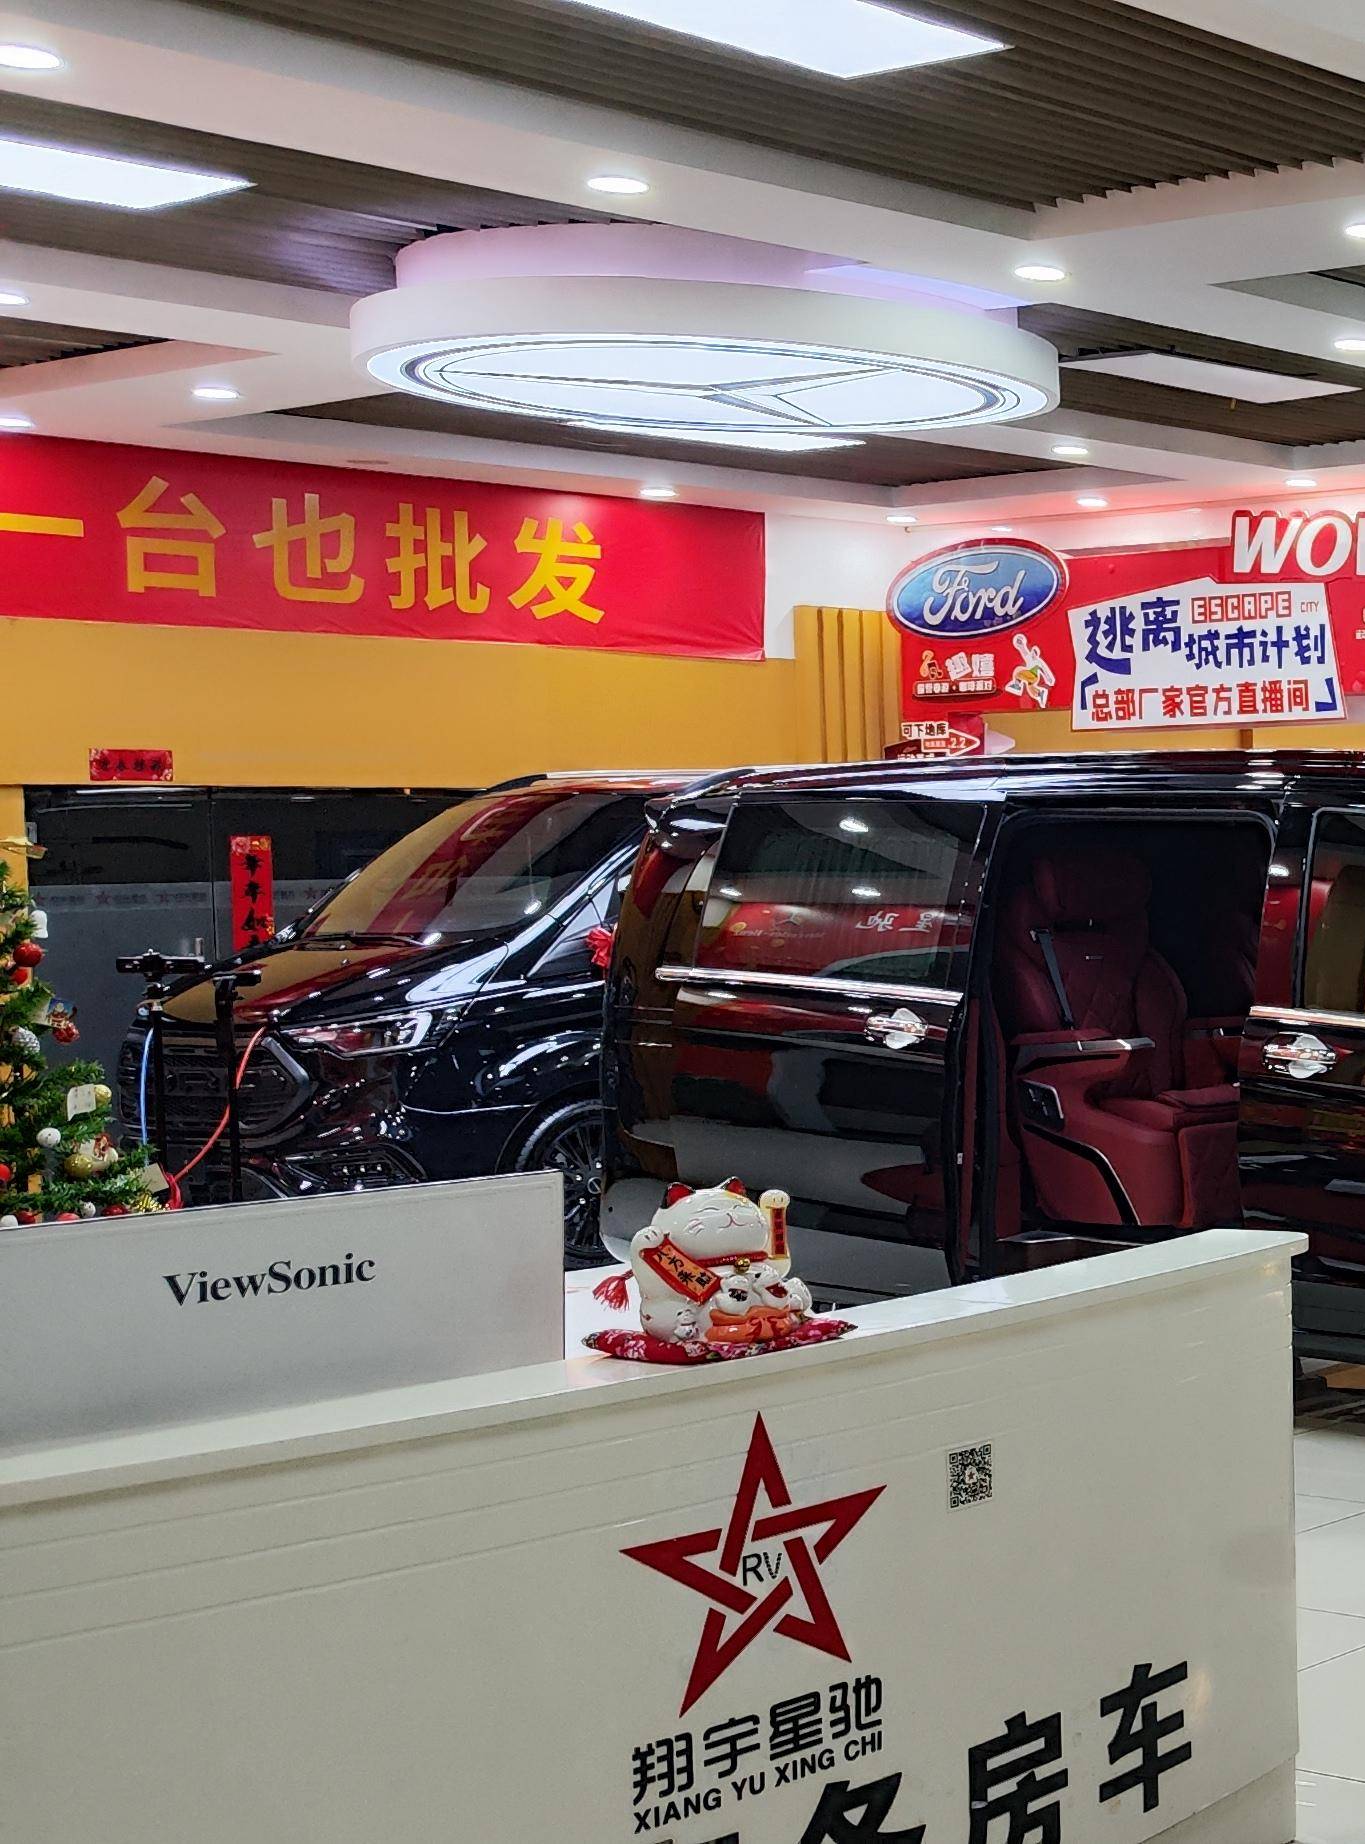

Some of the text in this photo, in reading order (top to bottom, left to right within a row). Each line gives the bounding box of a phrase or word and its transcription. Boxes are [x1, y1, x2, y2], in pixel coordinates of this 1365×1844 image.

[0, 475, 605, 624] 一台也批发
[923, 559, 1027, 627] Ford
[1191, 590, 1292, 625] ESCAPE
[1091, 678, 1311, 723] 总部厂家官方直播间
[161, 1252, 377, 1307] ViewSonic
[741, 1551, 783, 1587] RV
[631, 1674, 883, 1805] 翔宇星驰
[634, 1730, 883, 1834] XIANG YU XING CHI
